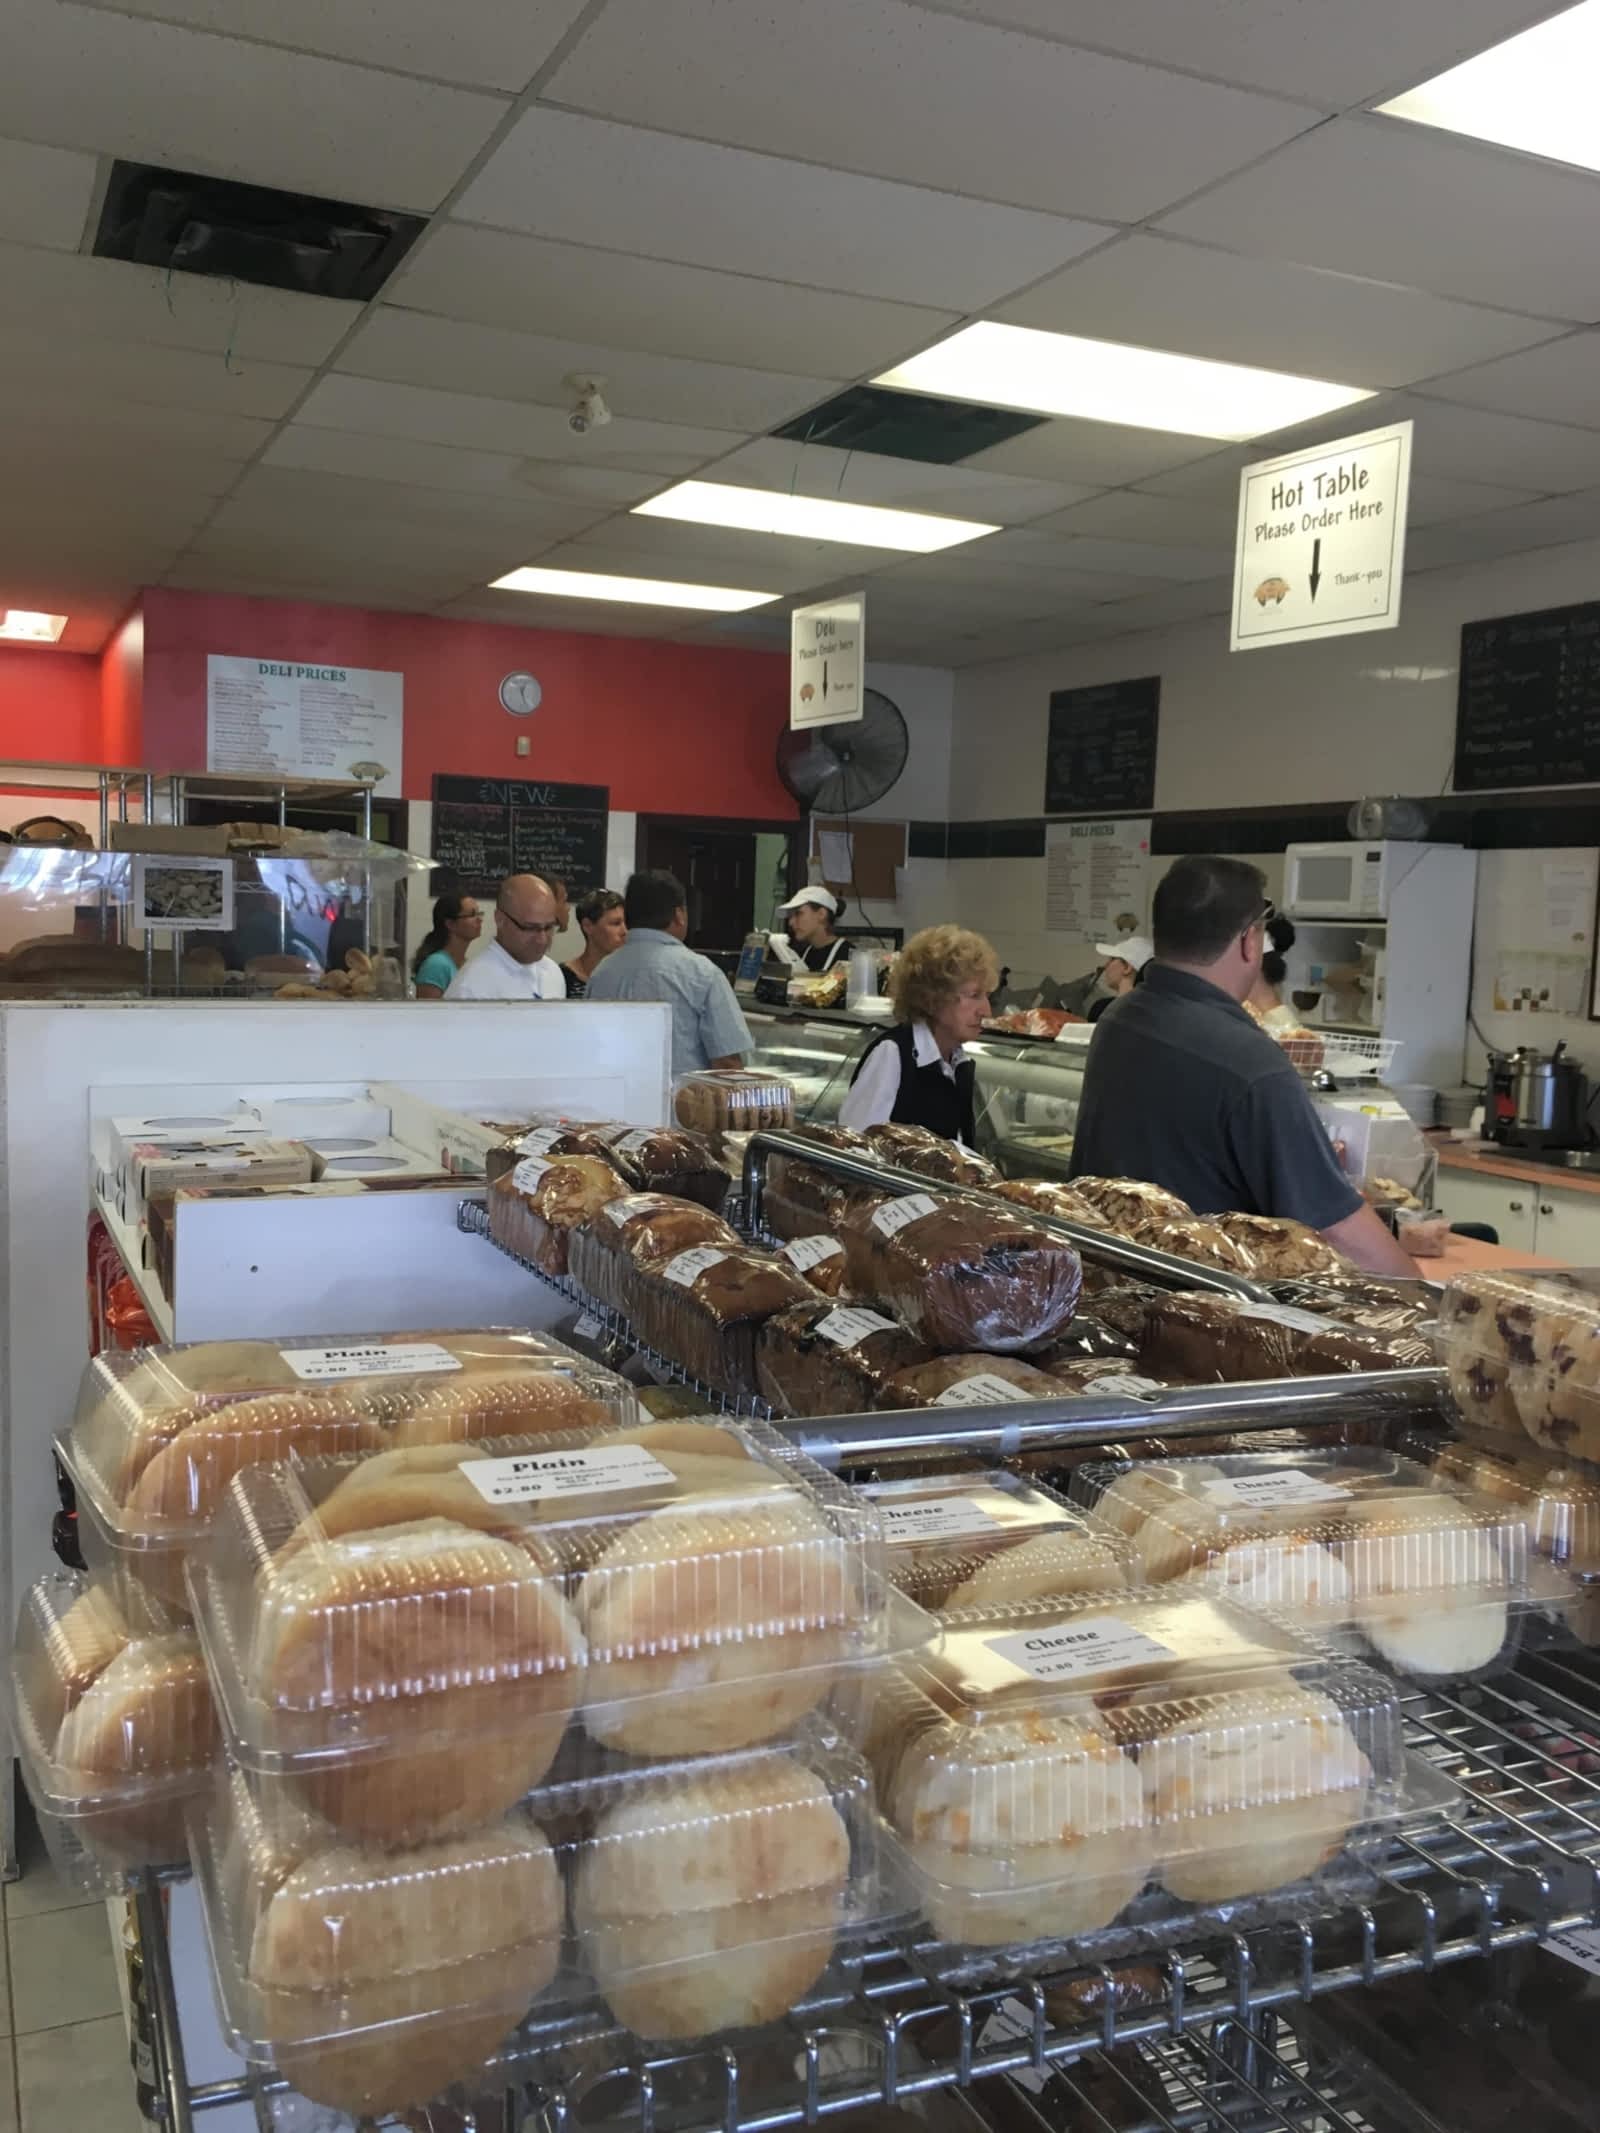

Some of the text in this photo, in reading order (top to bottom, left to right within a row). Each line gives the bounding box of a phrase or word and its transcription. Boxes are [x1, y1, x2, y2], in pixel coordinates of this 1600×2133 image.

[1271, 462, 1370, 511] Hot Table
[1254, 500, 1383, 543] Please Order Here
[258, 663, 347, 682] DELI PRICES
[324, 1349, 388, 1359] Plain
[511, 1457, 587, 1473] Plain
[1233, 1479, 1289, 1490] Cheese
[1024, 1630, 1100, 1651] Cheese
